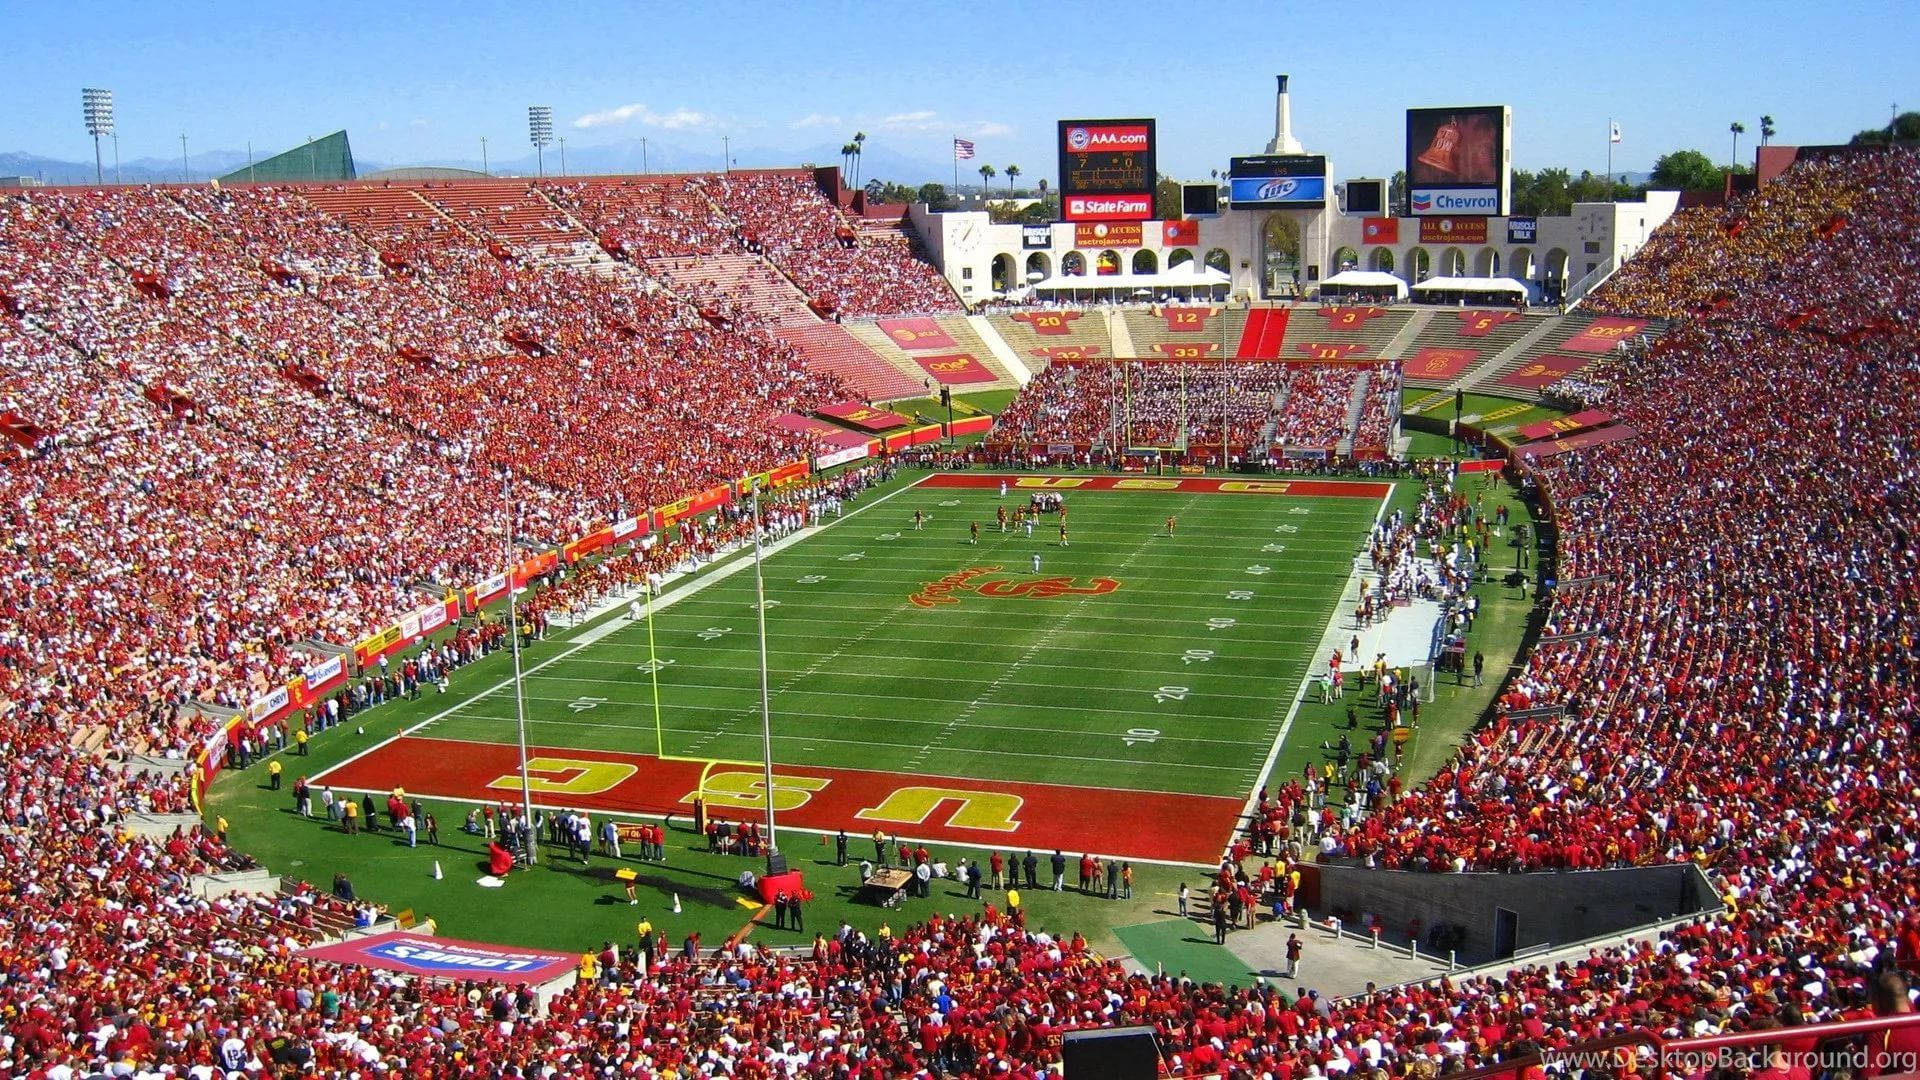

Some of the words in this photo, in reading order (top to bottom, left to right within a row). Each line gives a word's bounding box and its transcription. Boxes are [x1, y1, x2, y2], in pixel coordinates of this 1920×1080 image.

[1091, 133, 1147, 144] AAA.com
[1436, 195, 1496, 208] Chevron
[1423, 222, 1435, 230] ALL
[1456, 222, 1485, 230] ACCESS
[1509, 220, 1536, 230] MUSCLE
[1023, 227, 1051, 236] MUSCLE
[1077, 227, 1092, 235] ALL
[1109, 226, 1141, 235] ACCESS
[1513, 230, 1531, 239] MILK
[1028, 236, 1047, 245] MILK
[1077, 238, 1141, 248] usctrojans.com
[1422, 234, 1484, 242] usctrojans.com
[1038, 317, 1060, 326] 20
[1177, 313, 1198, 323] 12
[1342, 313, 1356, 323] 3
[1476, 319, 1492, 329] 5
[1174, 348, 1199, 357] 33
[1318, 349, 1338, 358] 11
[1154, 685, 1190, 701] 20
[1122, 728, 1161, 743] 10
[384, 946, 532, 970] LOWE'S
